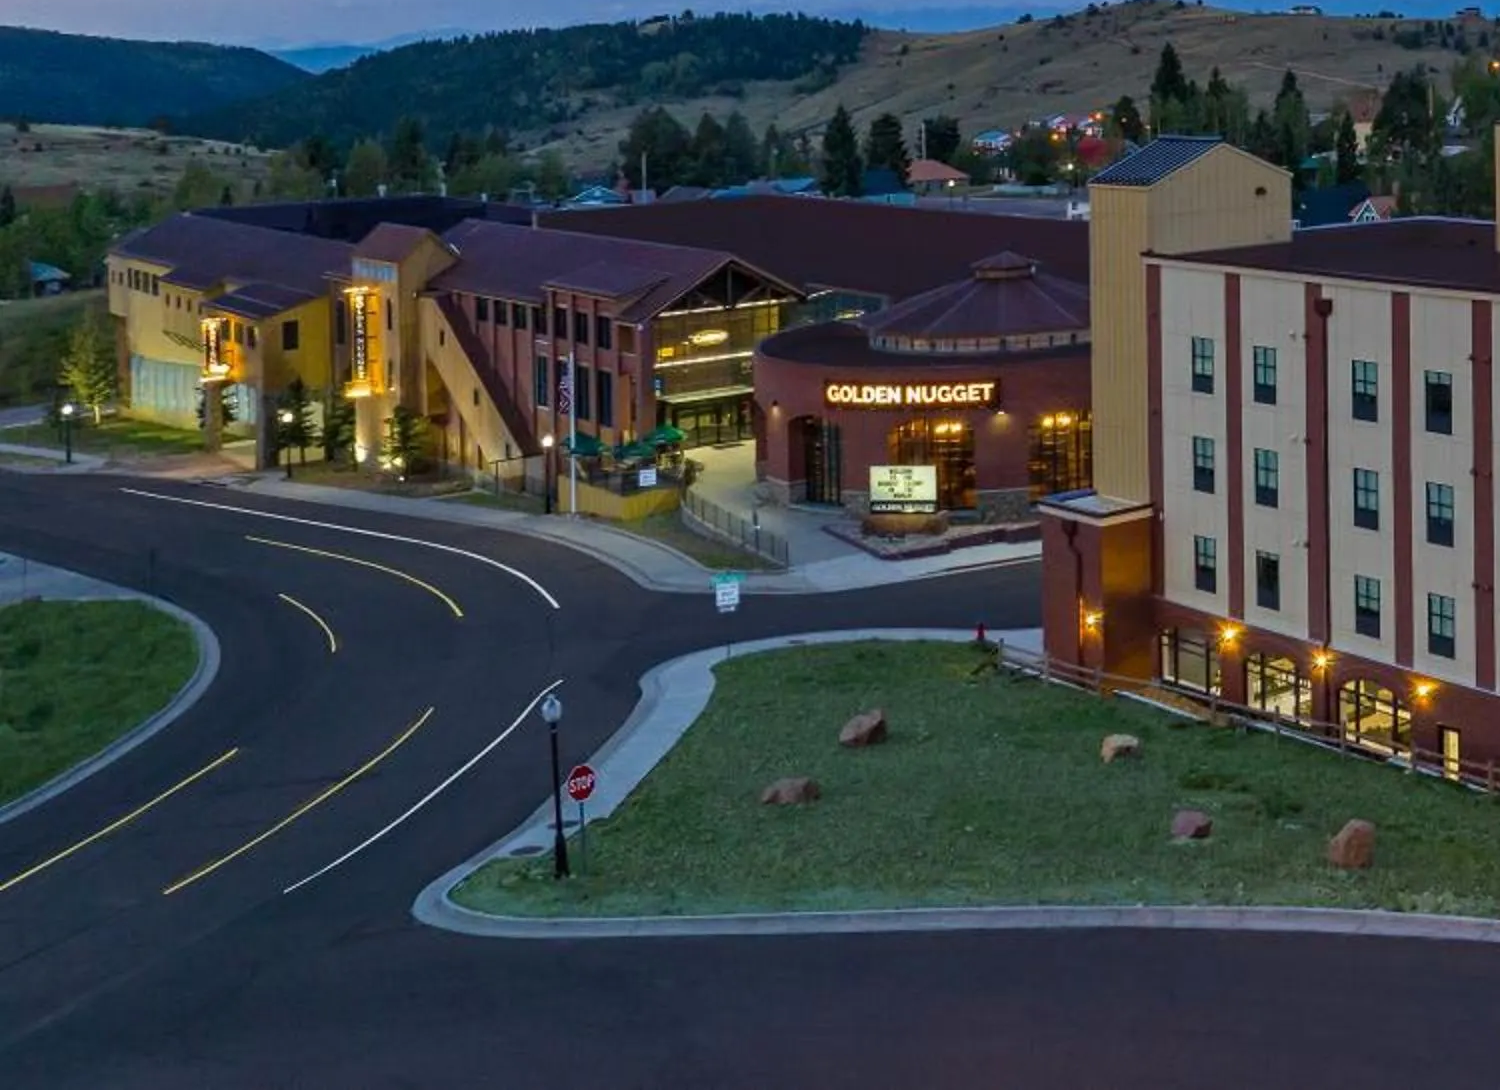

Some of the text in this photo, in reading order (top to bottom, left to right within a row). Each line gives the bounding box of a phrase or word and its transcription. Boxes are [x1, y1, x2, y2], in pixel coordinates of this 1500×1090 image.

[827, 383, 995, 404] GOLDEN NUGGET
[570, 774, 595, 793] STOP
